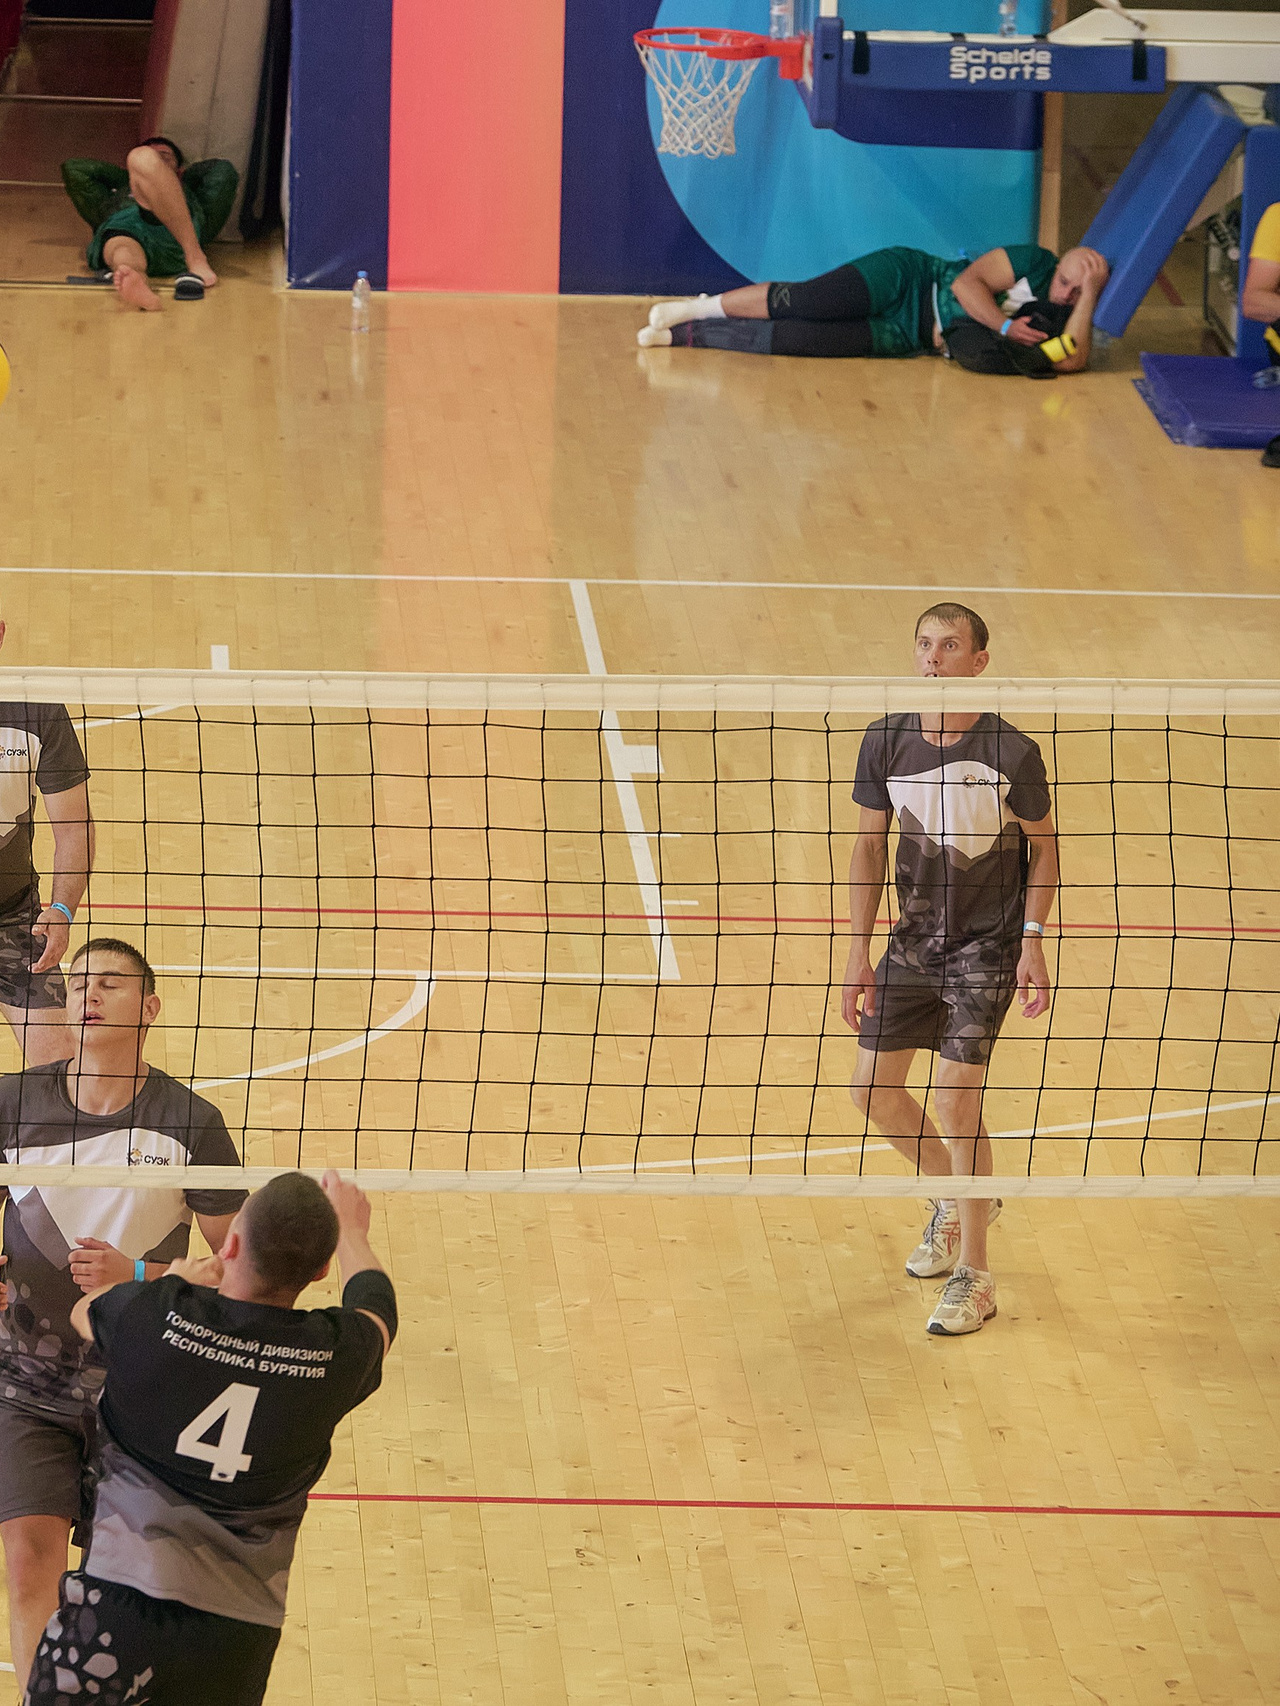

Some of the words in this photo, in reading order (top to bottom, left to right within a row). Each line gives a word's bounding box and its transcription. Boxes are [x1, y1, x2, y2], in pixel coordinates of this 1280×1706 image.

[950, 46, 1052, 65] Schelde
[950, 63, 1052, 84] Sports
[6, 748, 27, 757] СУЭК
[144, 1154, 170, 1166] СУЭК
[165, 1311, 261, 1354] ГОРНОРУДНЫЙ
[260, 1344, 334, 1362] ДИВИЗИОН
[162, 1329, 255, 1370] РЕСПУБЛИКА
[258, 1360, 326, 1379] БУРЯТИЯ
[175, 1382, 261, 1483] 4
